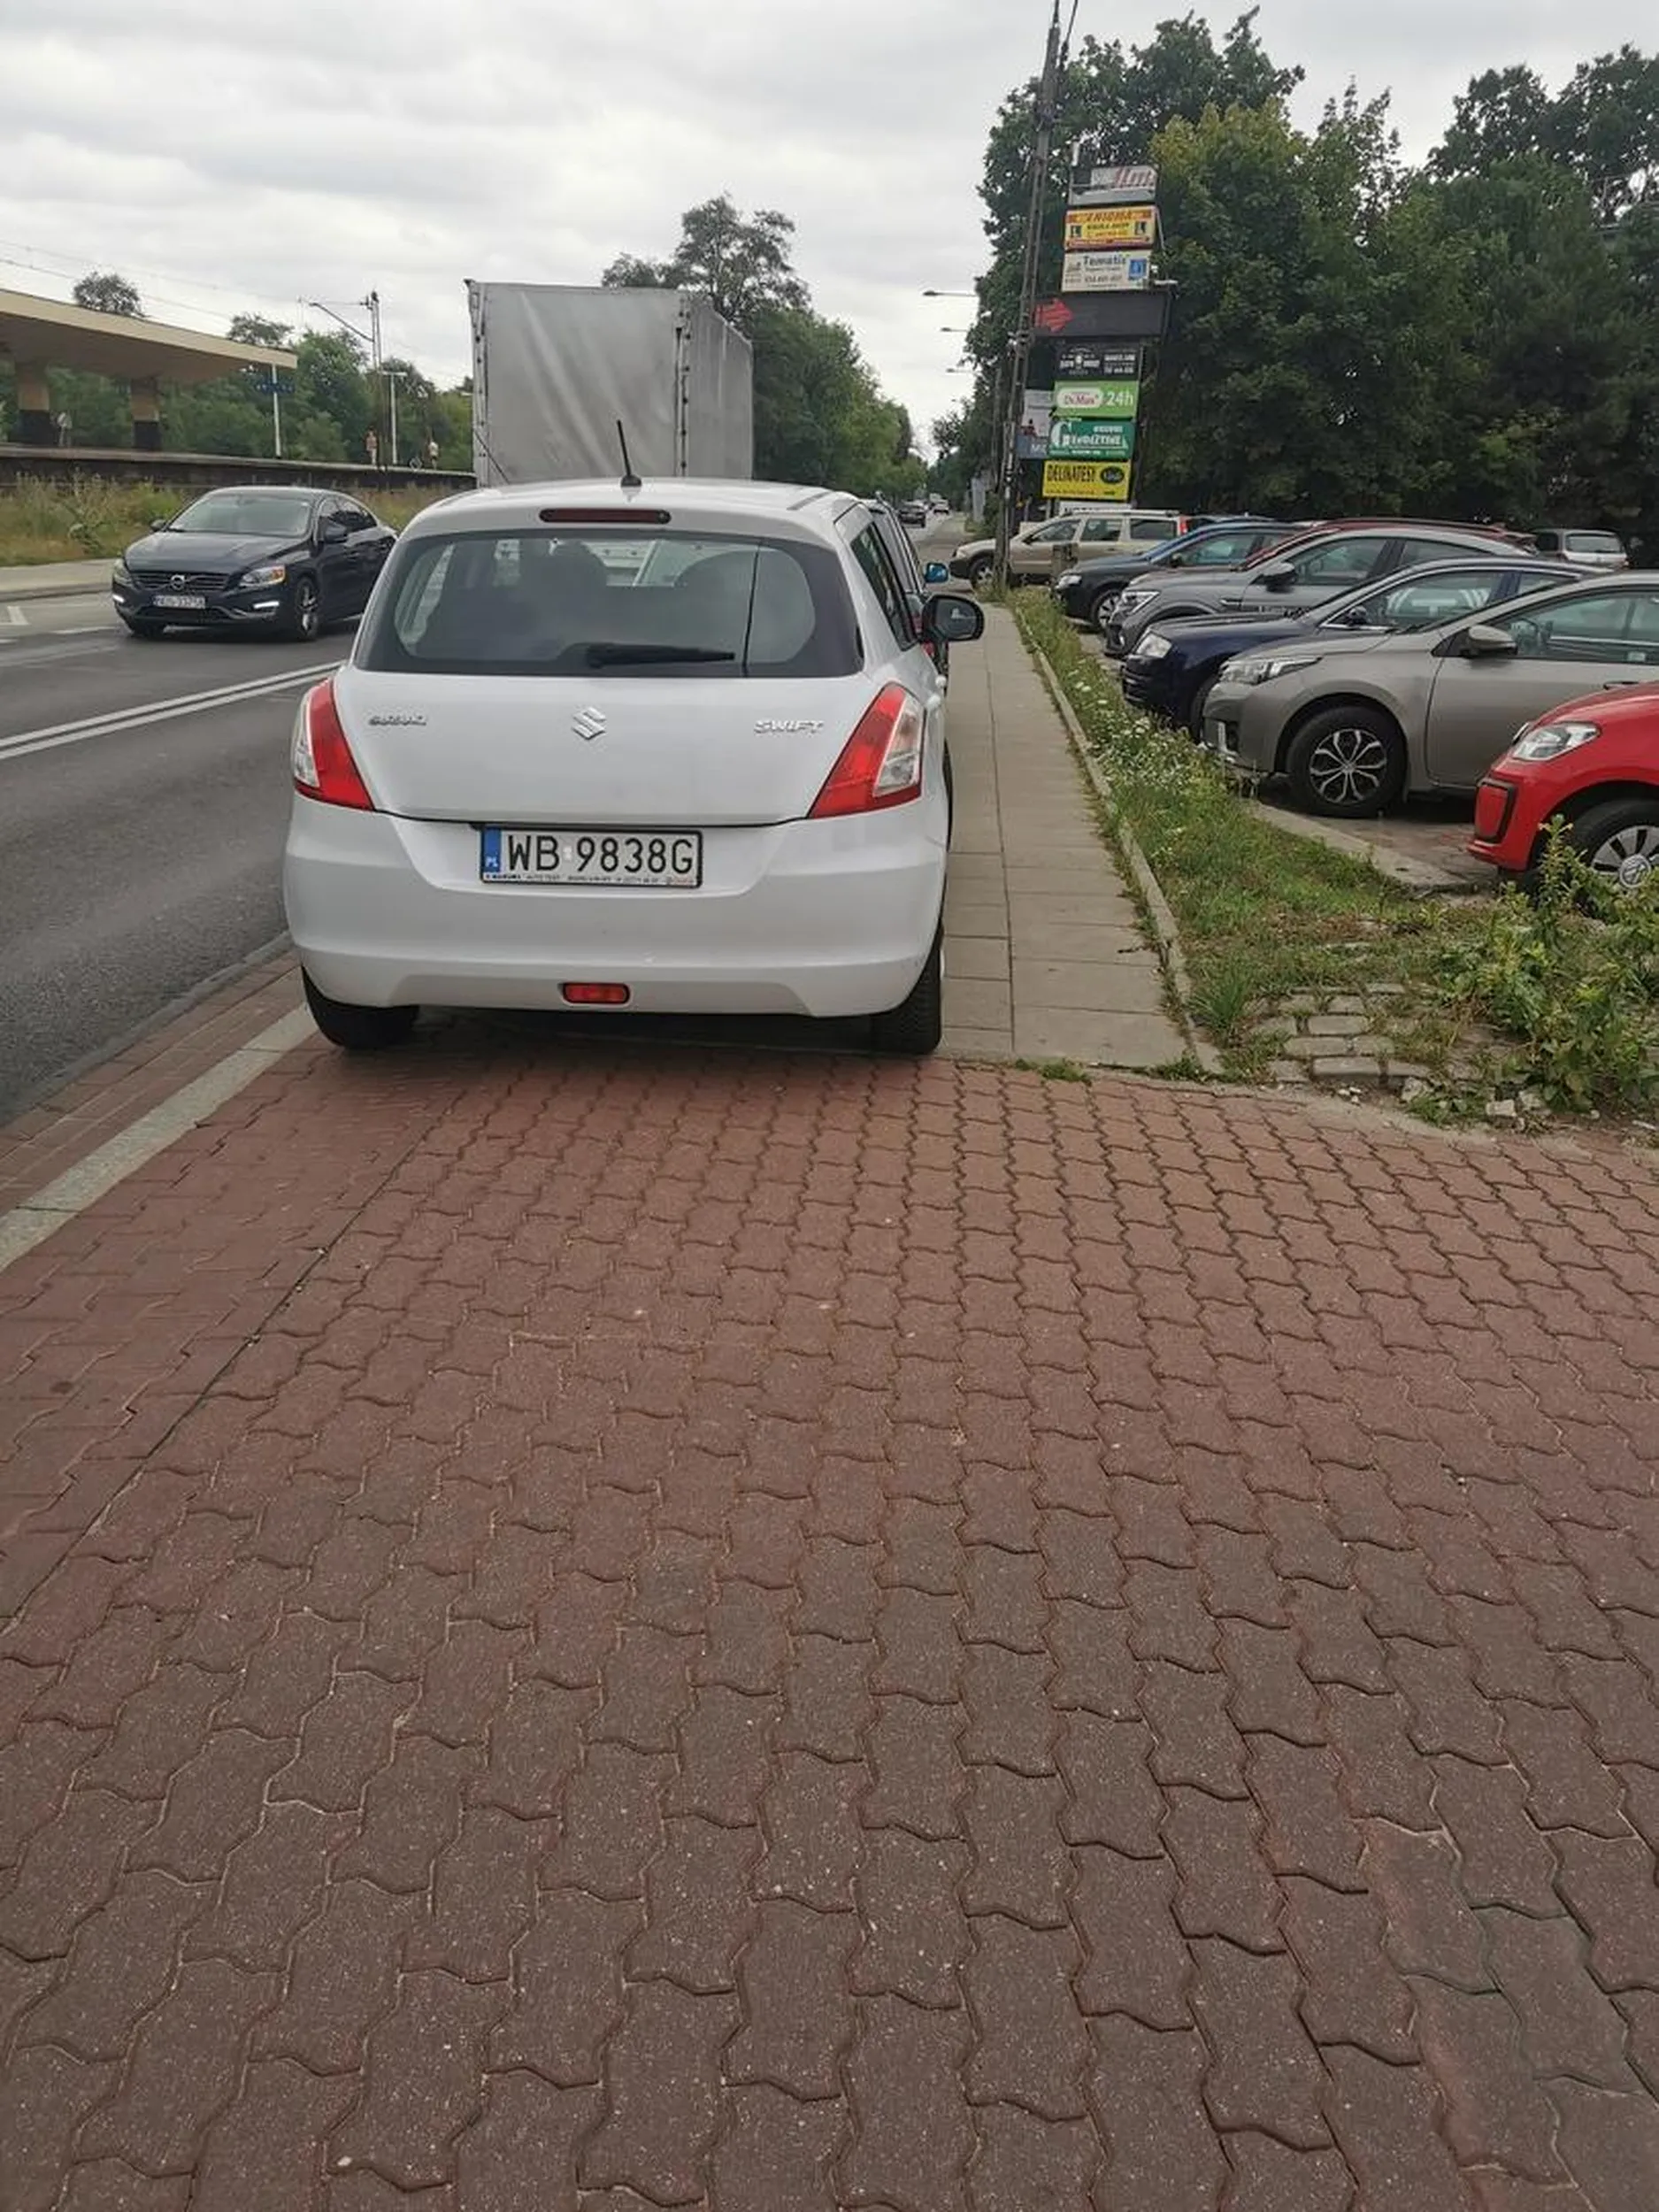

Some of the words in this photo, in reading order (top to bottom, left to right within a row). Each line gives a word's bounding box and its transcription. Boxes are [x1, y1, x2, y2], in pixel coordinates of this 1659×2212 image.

[1106, 391, 1133, 406] 24h
[753, 719, 825, 734] SWIFT
[485, 856, 499, 868] PL
[508, 834, 560, 872] WB
[576, 836, 693, 875] 9838G
